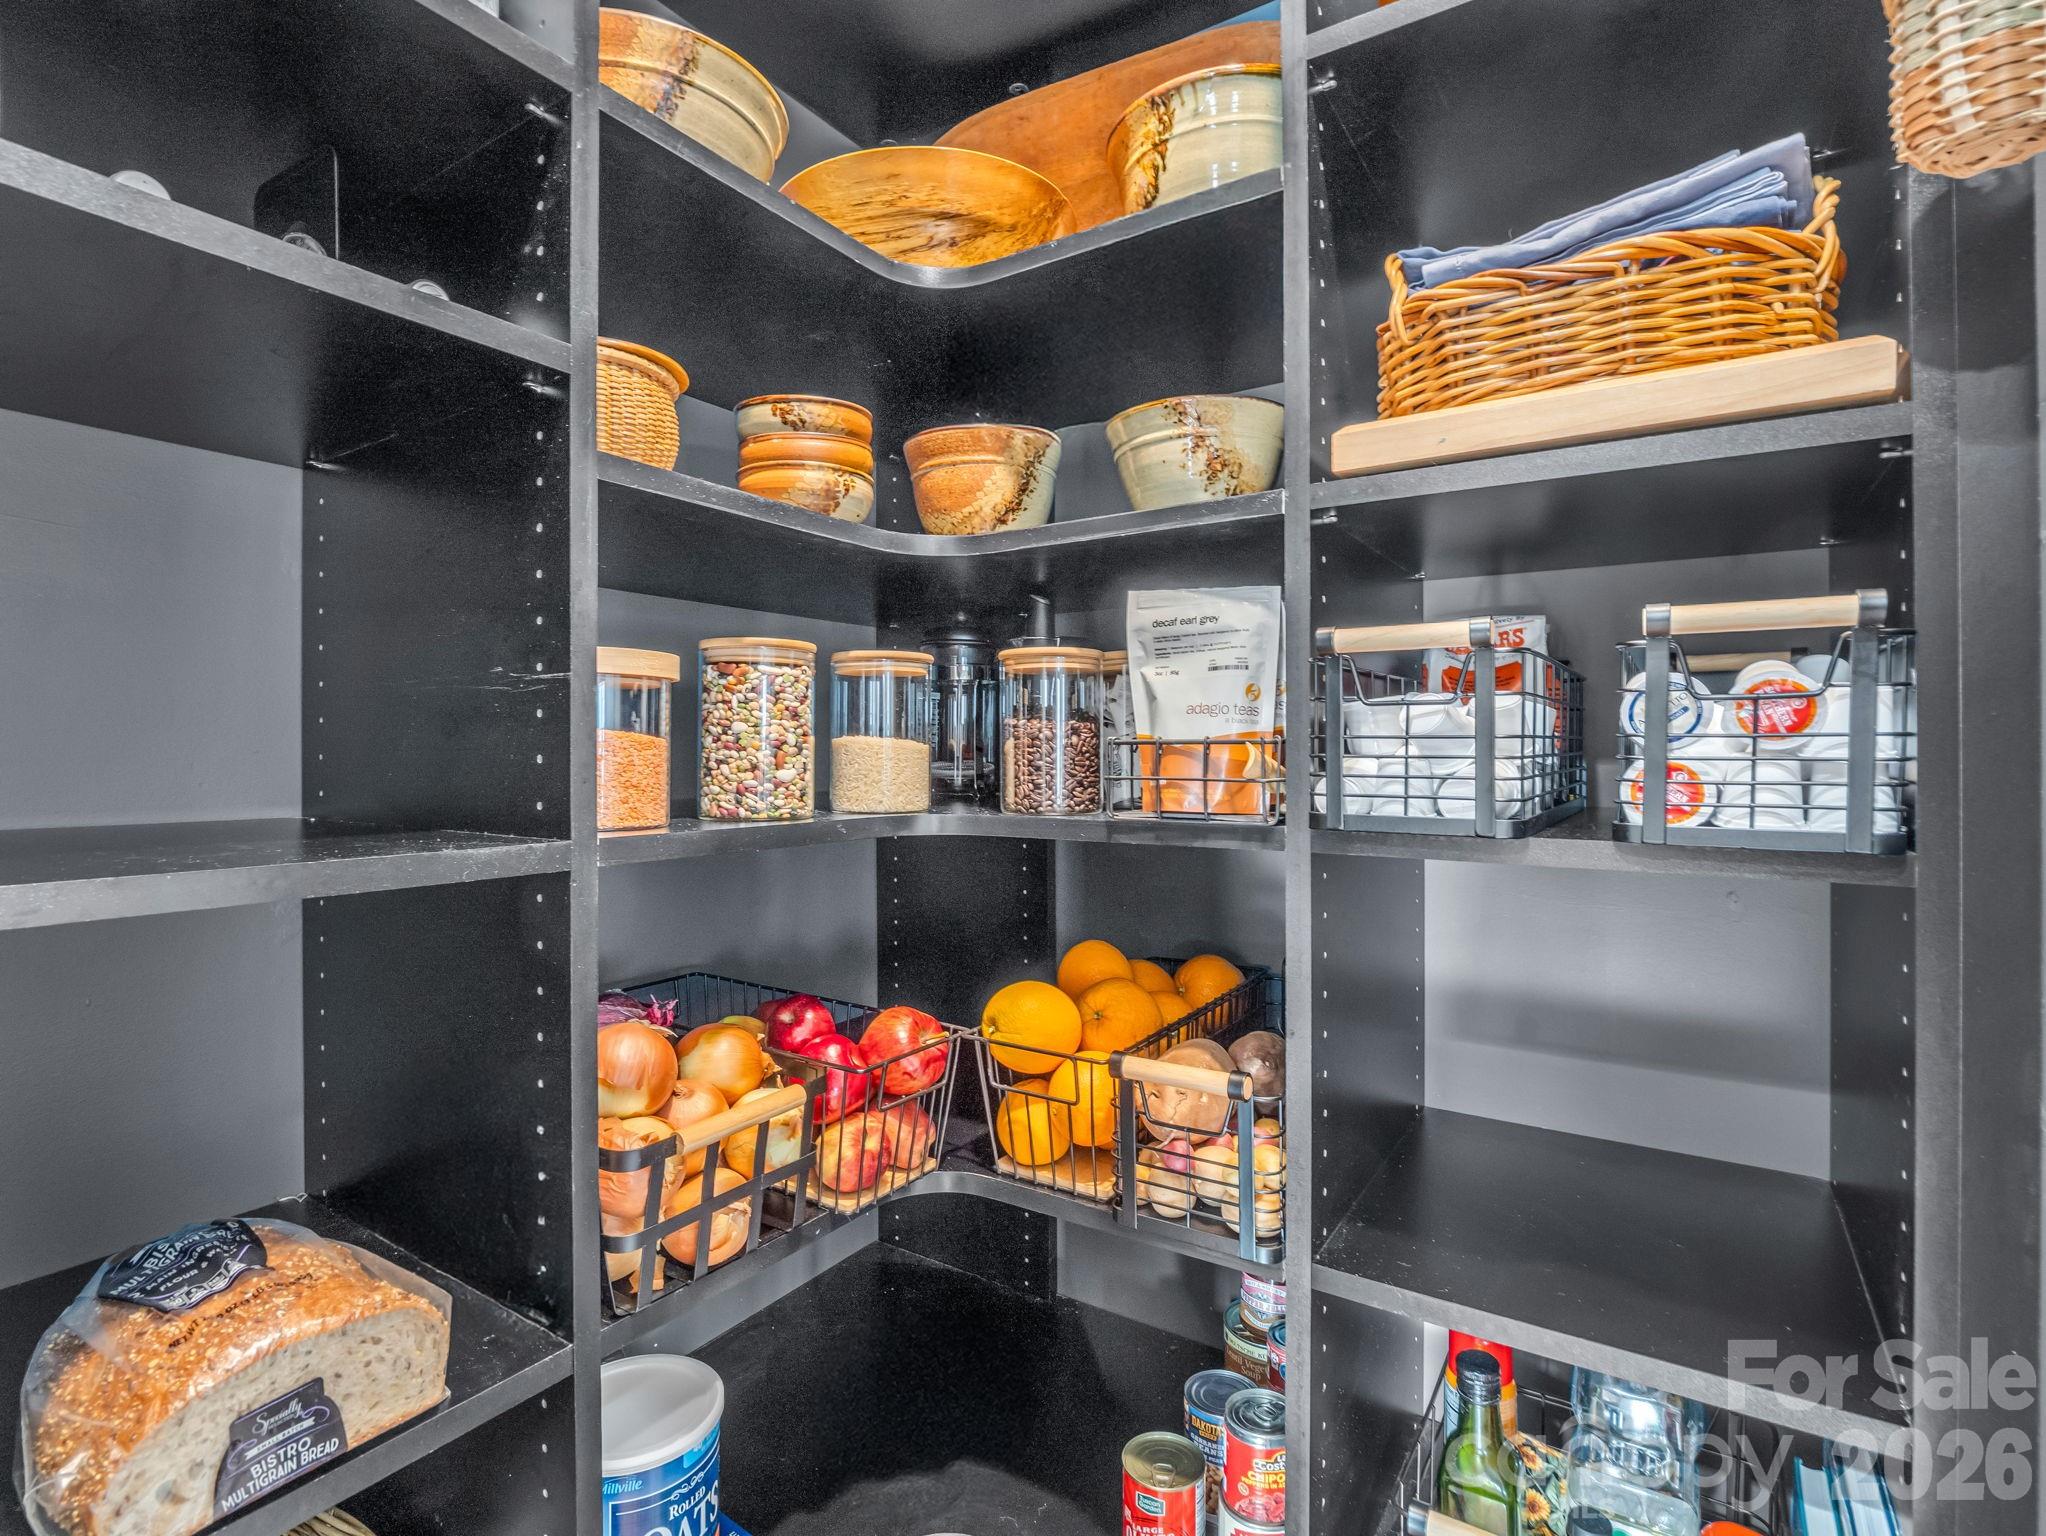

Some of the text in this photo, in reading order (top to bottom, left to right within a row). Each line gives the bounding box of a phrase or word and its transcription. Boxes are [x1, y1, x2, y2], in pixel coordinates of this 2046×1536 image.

[1152, 614, 1219, 629] decaf earl grey
[1186, 702, 1230, 717] adagio
[1233, 703, 1260, 717] teas
[160, 1269, 198, 1292] FLOUR
[1241, 1365, 1261, 1382] Soup
[1243, 1358, 1265, 1373] Vege
[252, 1398, 303, 1437] Specially
[250, 1436, 311, 1479] BISTRO
[1258, 1460, 1286, 1471] Cost
[221, 1437, 340, 1512] MULTIGRAIN BREAD
[1247, 1470, 1286, 1483] CHIPO
[643, 1479, 719, 1536] ATS
[669, 1485, 706, 1520] ROLLED
[1132, 1523, 1164, 1534] LARGE
